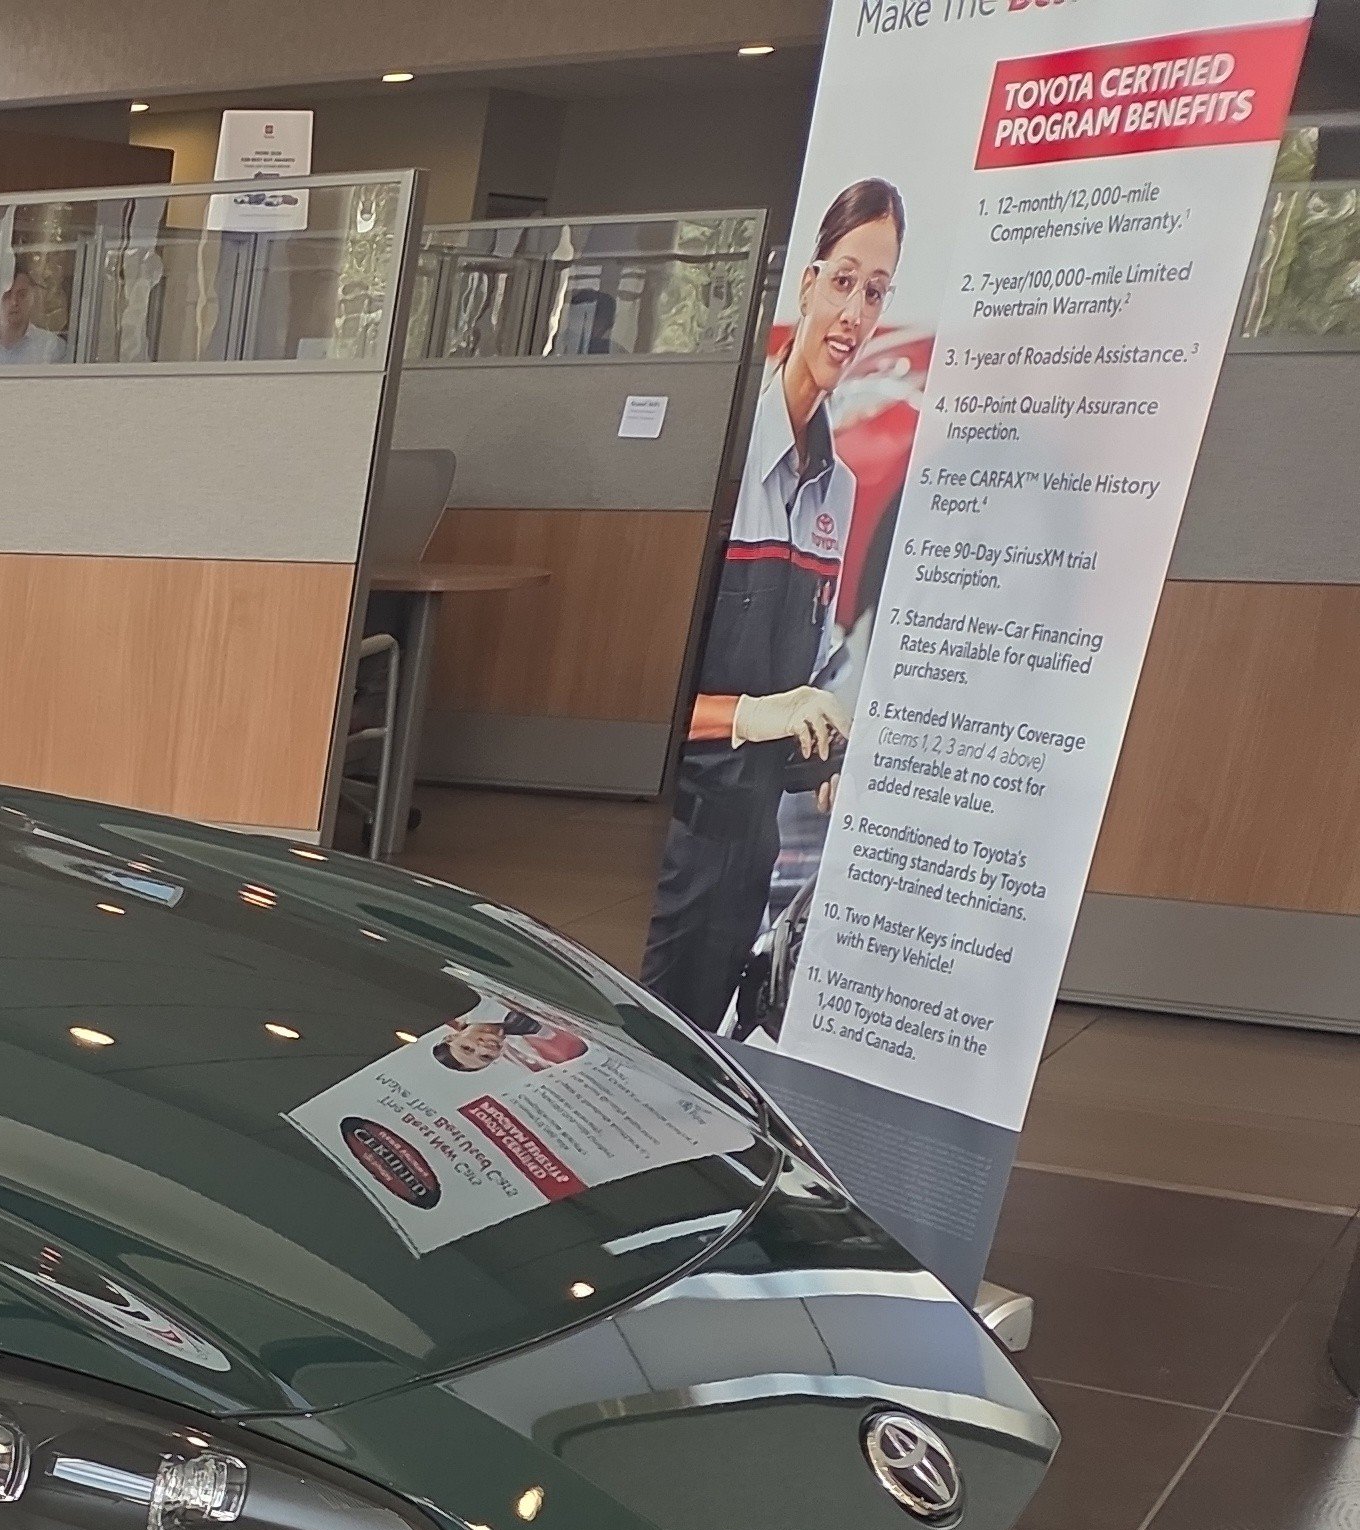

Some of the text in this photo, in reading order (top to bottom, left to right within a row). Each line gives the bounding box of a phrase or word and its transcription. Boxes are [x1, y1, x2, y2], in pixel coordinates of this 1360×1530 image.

[856, 0, 930, 37] Make
[1004, 52, 1235, 112] TOYOTA CERTIFIED
[994, 88, 1257, 148] PROGRAM BENEFITS
[979, 181, 1160, 216] 1. 12-month/12,000-mile
[990, 216, 1103, 245] Comprehensive
[961, 274, 975, 292] 2.
[1125, 261, 1193, 284] Limited
[973, 297, 1048, 318] Powertrain
[945, 344, 1187, 370] 3. 1-year of Roadside Assistance.
[935, 395, 1158, 419] 4. 160-Point Quality Assurance
[947, 422, 1019, 444] Inspection.
[919, 468, 932, 485] 5.
[937, 468, 967, 486] Free
[1043, 472, 1092, 492] Vehicle
[1095, 474, 1161, 499] History
[904, 538, 1098, 570] 6. Free 90-Day SiriusXM trial
[915, 565, 1000, 590] Subscription.
[890, 608, 1103, 653] 7. Standard New-Car Financing
[893, 661, 968, 685] purchasers.
[900, 634, 1093, 674] Rates Available for qualified
[869, 701, 1086, 753] 8. Extended Warranty Coverage
[878, 726, 1046, 773] (items 3 and 4 above)
[868, 775, 994, 814] added resale value.
[873, 752, 1046, 797] transferable at no cost for
[842, 814, 1027, 868] 9. Reconditioned to Toyota's
[847, 863, 1026, 921] factory-trained technicians.
[853, 845, 1046, 899] exacting standards by Toyota
[824, 903, 1013, 964] 10. Two Master Keys included
[836, 930, 955, 974] with Every Vehicle!
[808, 966, 994, 1031] 11. Warranty honored at over
[812, 1014, 916, 1060] U.S. and Canada.
[818, 992, 987, 1056] 1,400 Toyota dealers in the
